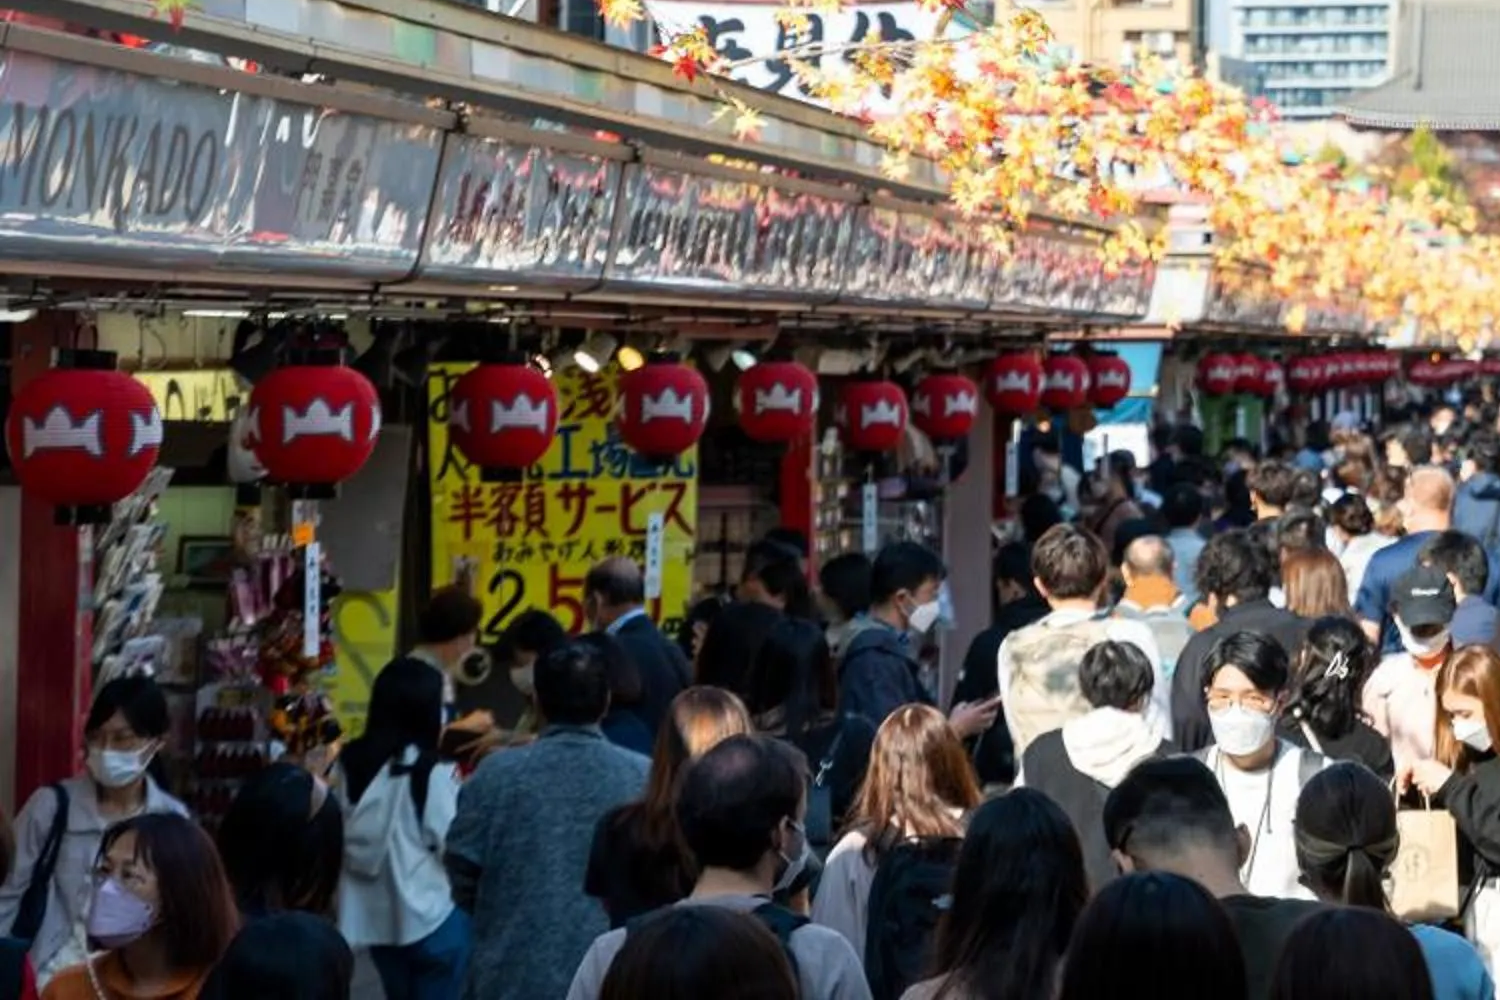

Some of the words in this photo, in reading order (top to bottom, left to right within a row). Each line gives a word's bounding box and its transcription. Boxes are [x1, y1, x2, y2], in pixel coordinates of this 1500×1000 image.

[449, 483, 694, 541] 半額サービス
